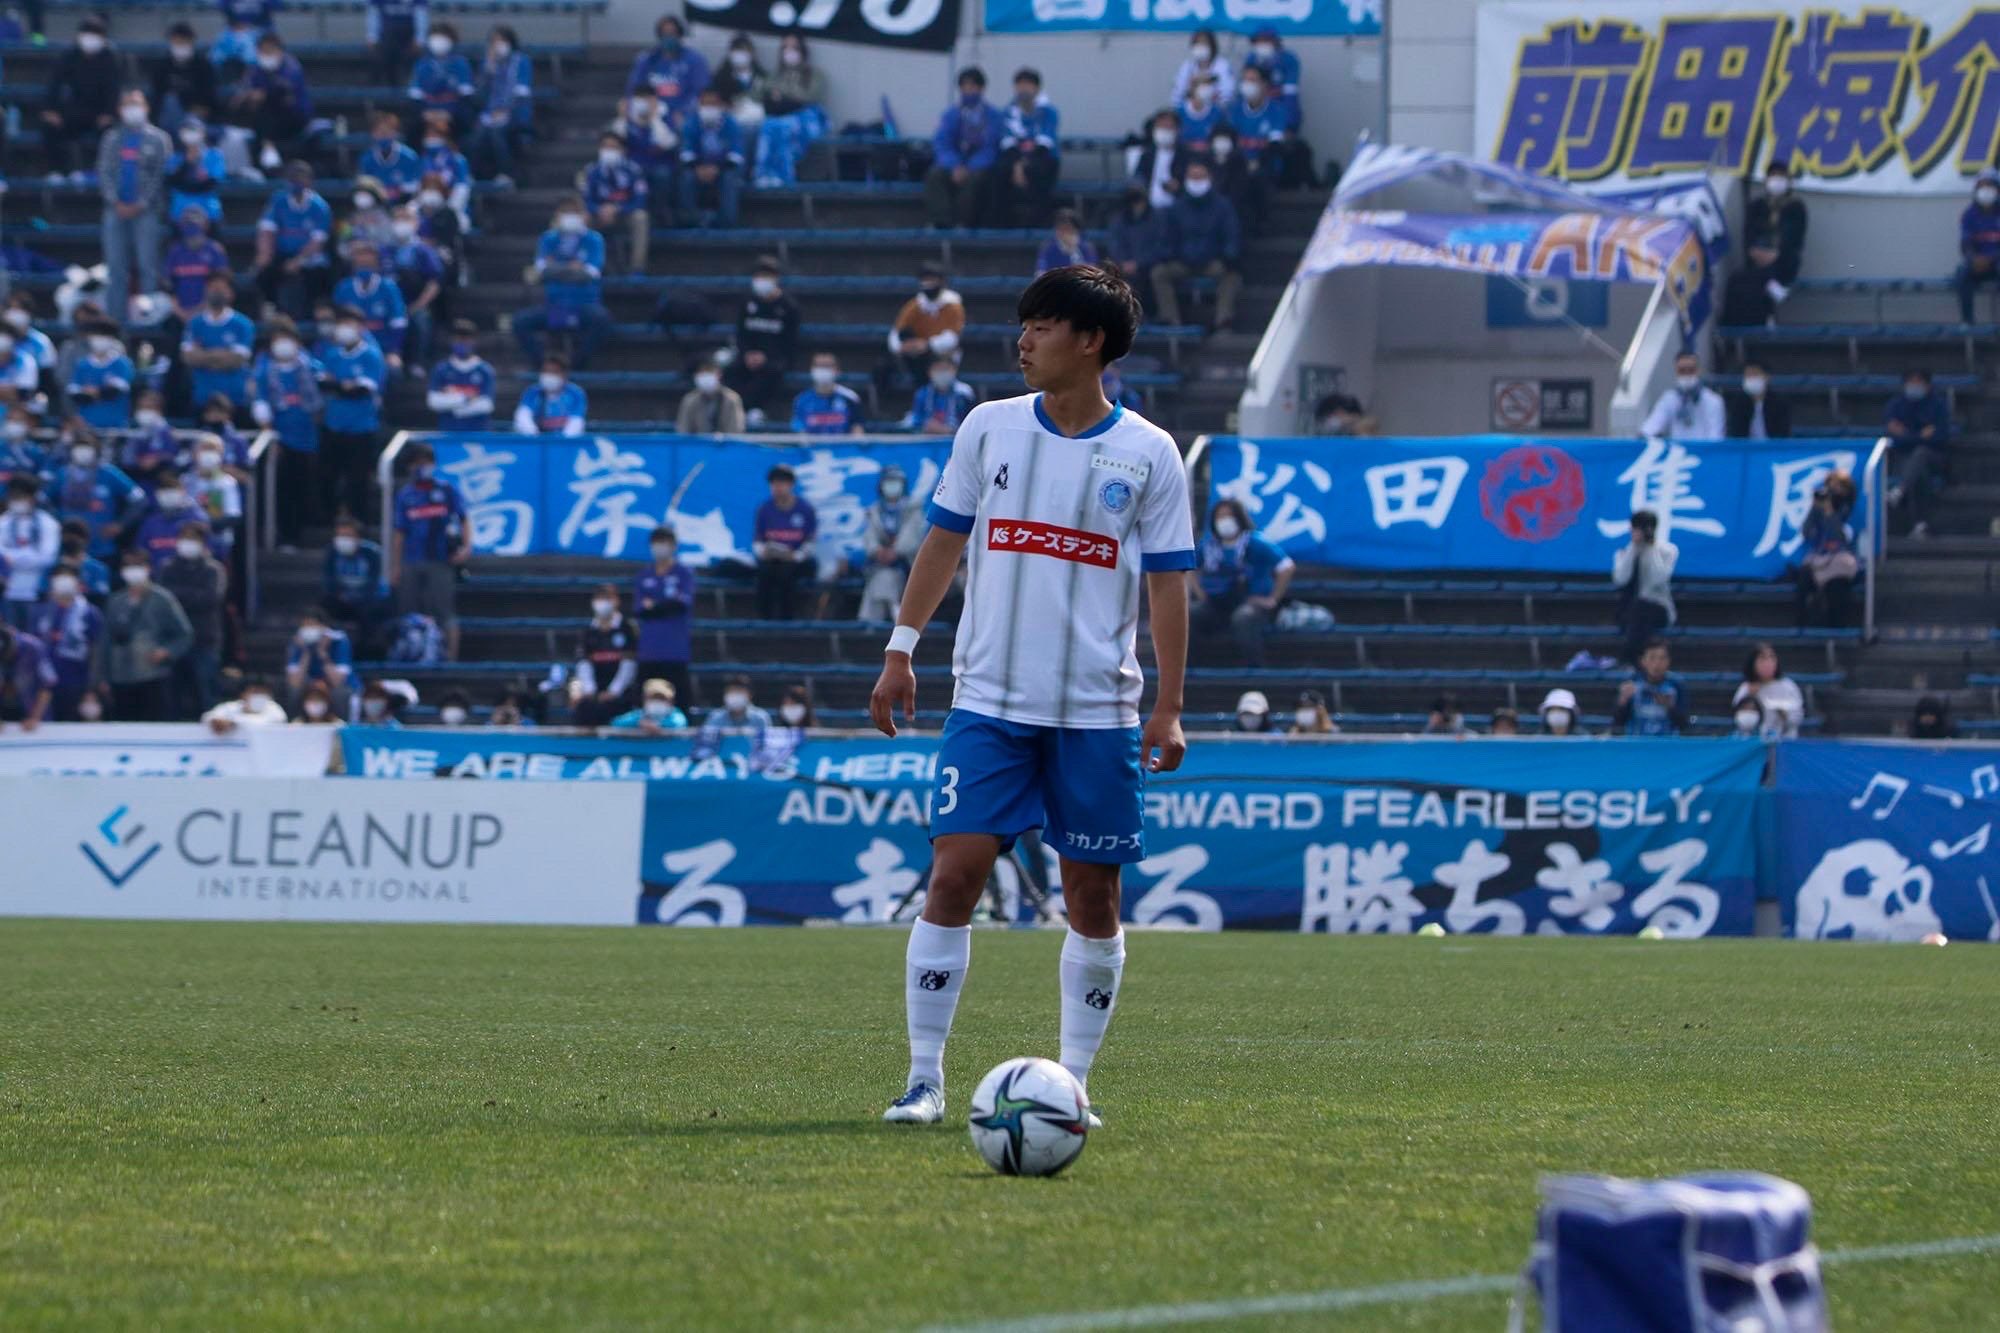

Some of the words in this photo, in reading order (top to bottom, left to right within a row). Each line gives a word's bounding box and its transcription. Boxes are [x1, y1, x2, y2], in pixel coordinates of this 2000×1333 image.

[1095, 457, 1145, 477] ADASTRIA
[1013, 526, 1114, 561] ケーズデンキ
[363, 747, 437, 778] WE
[451, 750, 566, 779] ARE
[814, 751, 939, 783] HER
[778, 789, 933, 826] ADVA
[1343, 786, 1712, 829] FEARLESSLY.
[938, 766, 960, 815] 3
[177, 808, 504, 870] CLEANUP
[198, 875, 471, 904] INTERNATIONAL
